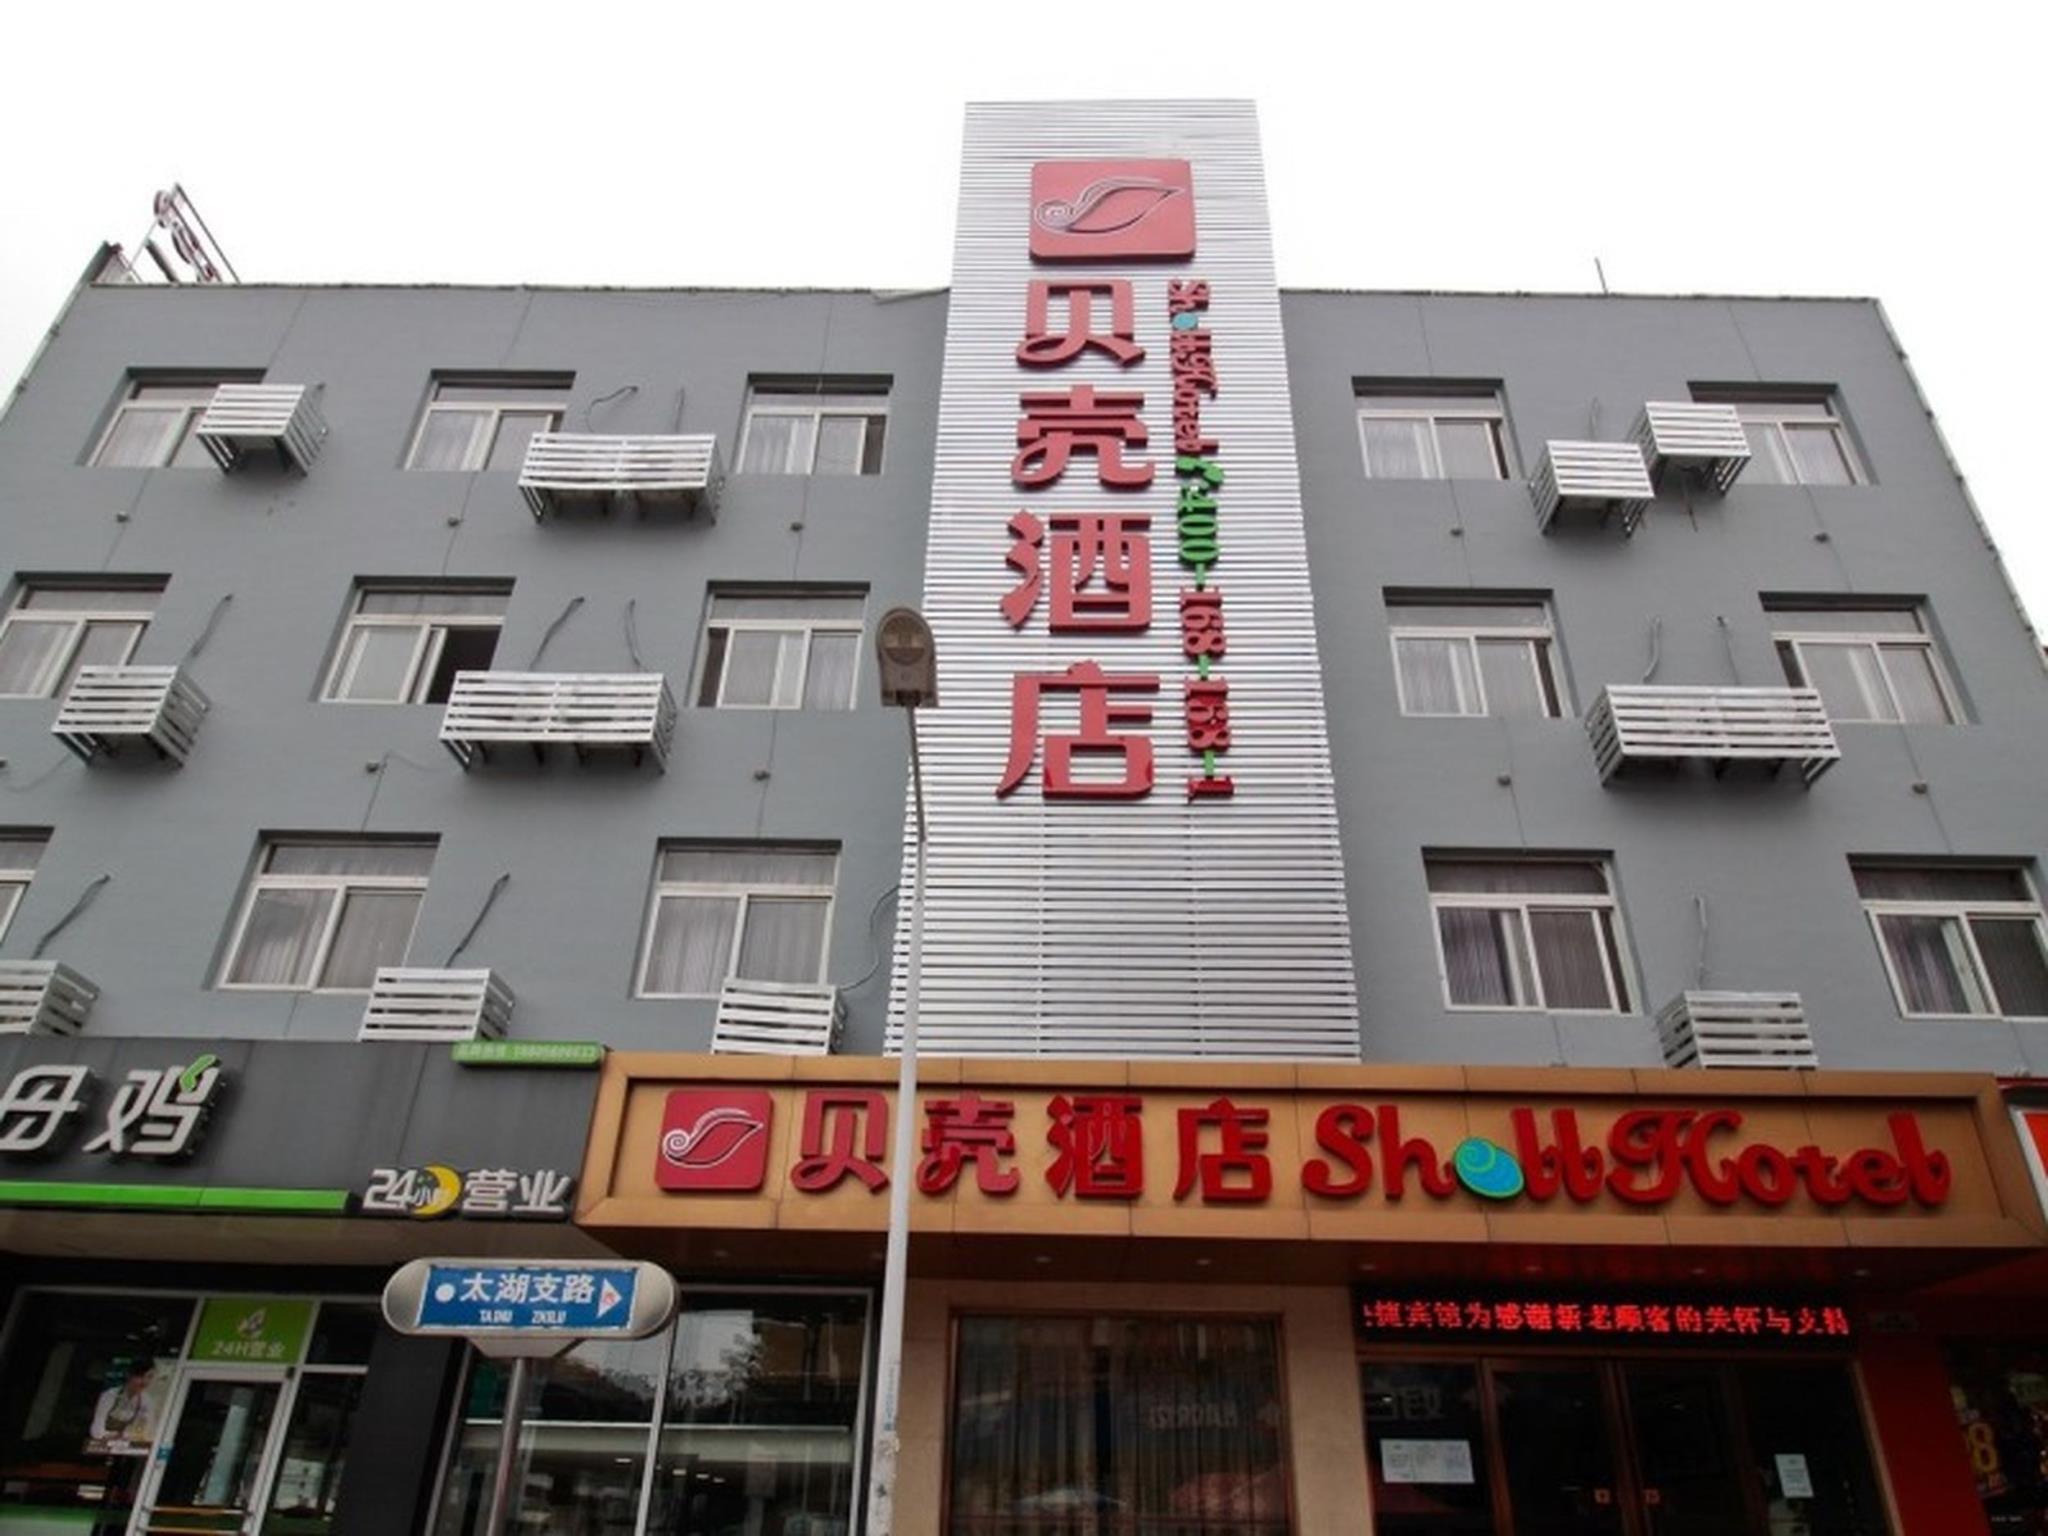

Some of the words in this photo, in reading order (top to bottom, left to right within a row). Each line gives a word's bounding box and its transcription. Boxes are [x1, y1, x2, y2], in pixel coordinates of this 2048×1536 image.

[996, 277, 1160, 800] 贝壳酒店
[0, 1055, 221, 1154] 母鸡
[790, 1089, 1273, 1202] 贝壳酒店
[459, 1272, 596, 1304] 太湖支路
[1363, 1300, 1850, 1335] 捷宾馆为感谢新老顾客的关怀与支持
